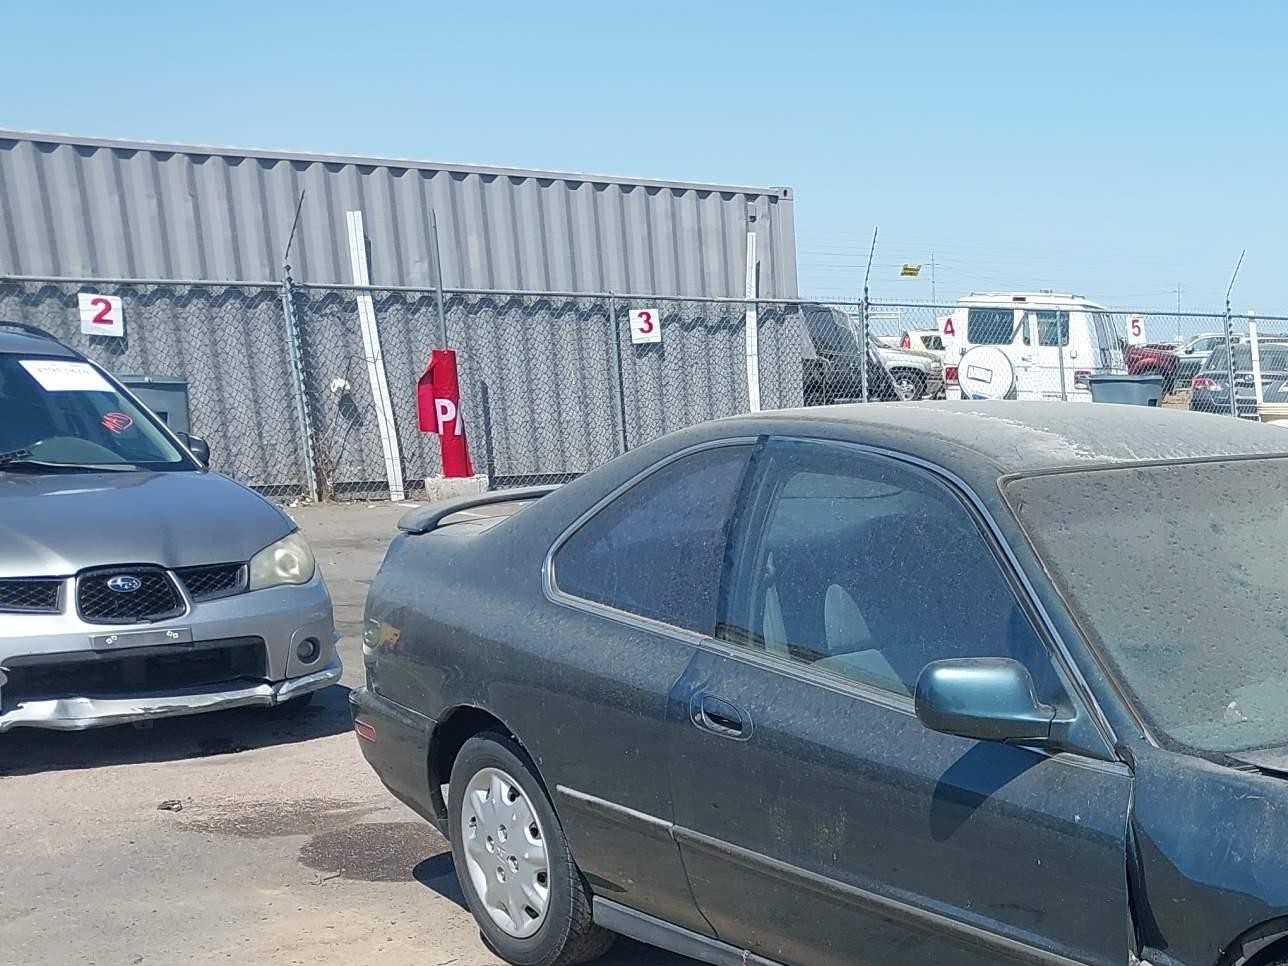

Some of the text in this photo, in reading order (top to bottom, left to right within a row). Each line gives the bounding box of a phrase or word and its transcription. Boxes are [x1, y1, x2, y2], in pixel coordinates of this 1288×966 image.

[90, 298, 114, 325] 2
[637, 311, 654, 334] 3
[943, 317, 956, 337] 4
[1131, 319, 1142, 337] 5
